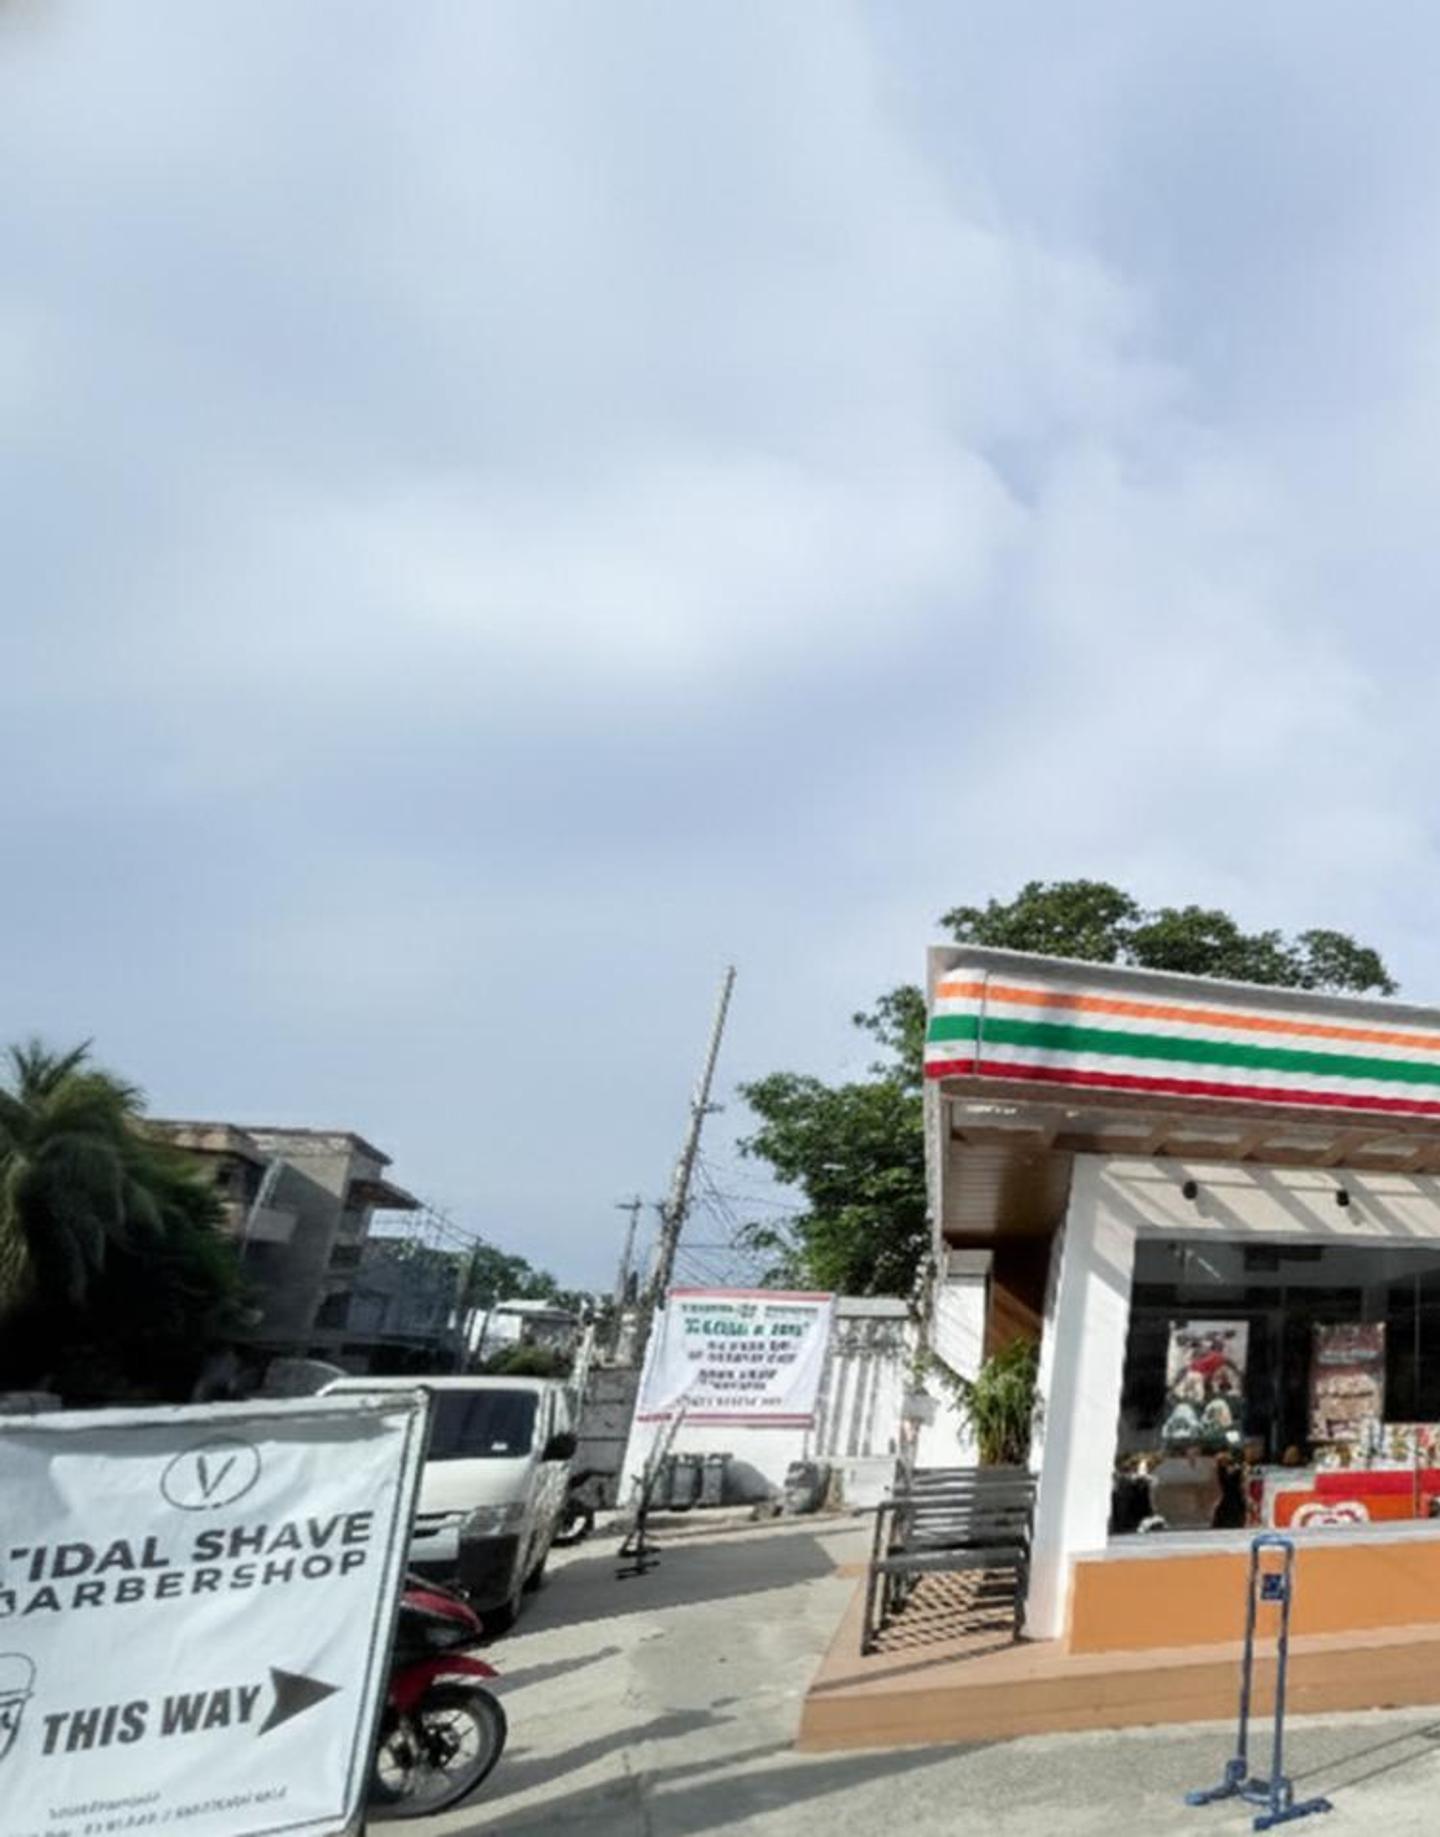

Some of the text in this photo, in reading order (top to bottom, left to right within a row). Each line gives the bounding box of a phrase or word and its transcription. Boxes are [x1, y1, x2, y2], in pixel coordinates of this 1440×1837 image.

[191, 1510, 374, 1563] SHAVE
[41, 1684, 263, 1756] THIS WAY
